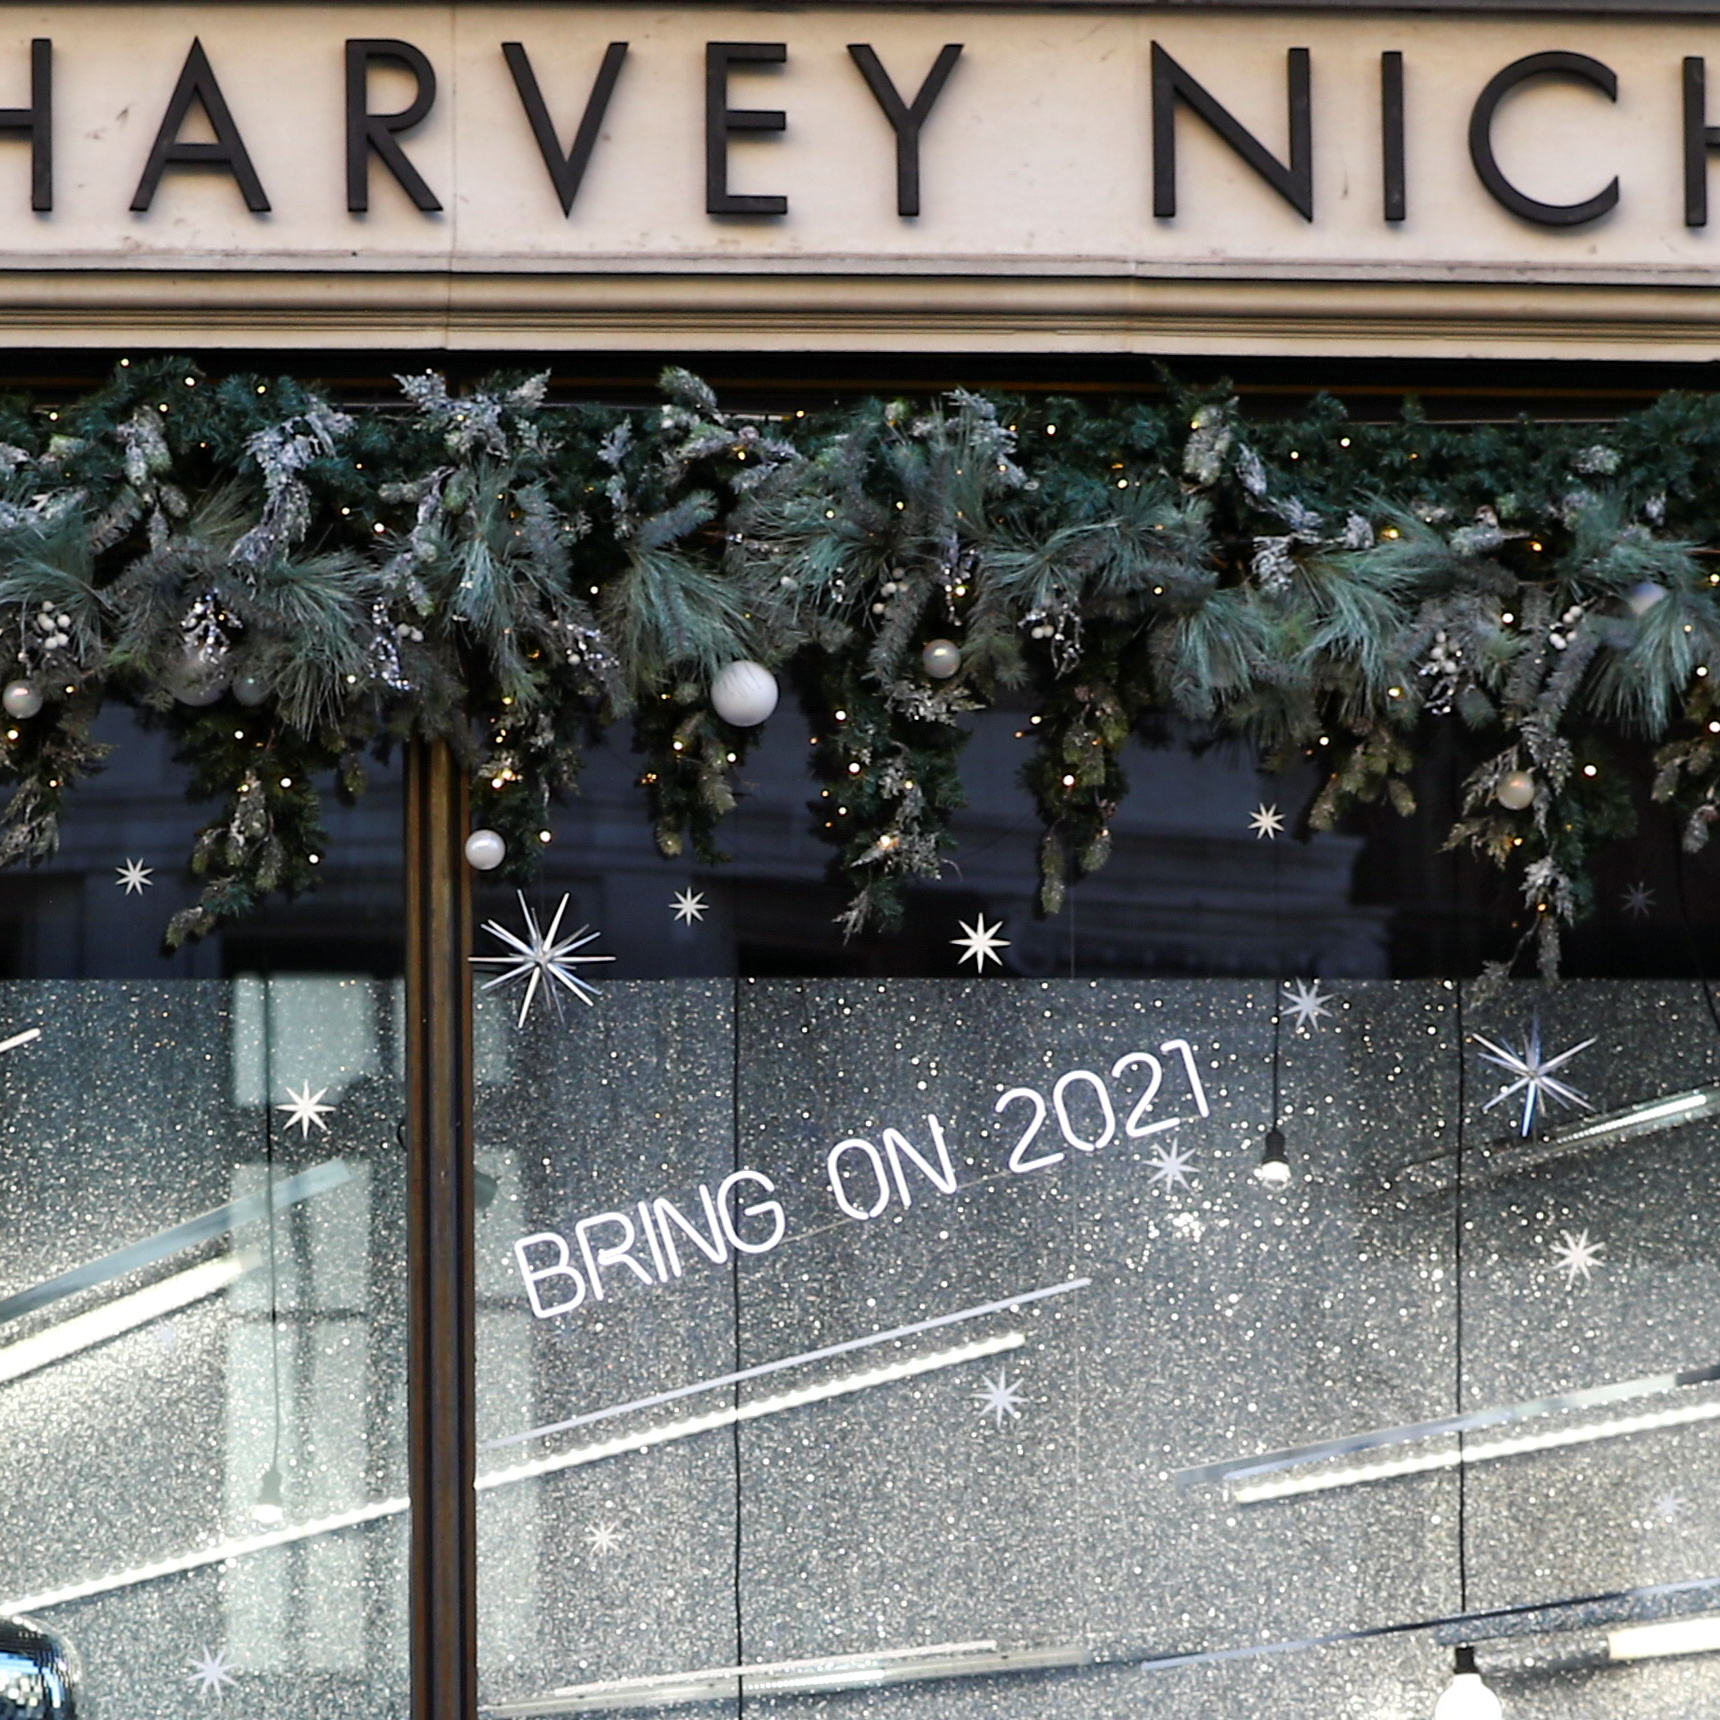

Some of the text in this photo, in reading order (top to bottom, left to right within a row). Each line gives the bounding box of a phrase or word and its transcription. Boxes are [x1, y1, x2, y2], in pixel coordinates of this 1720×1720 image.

[514, 1039, 1210, 1319] BRING ON 2021
